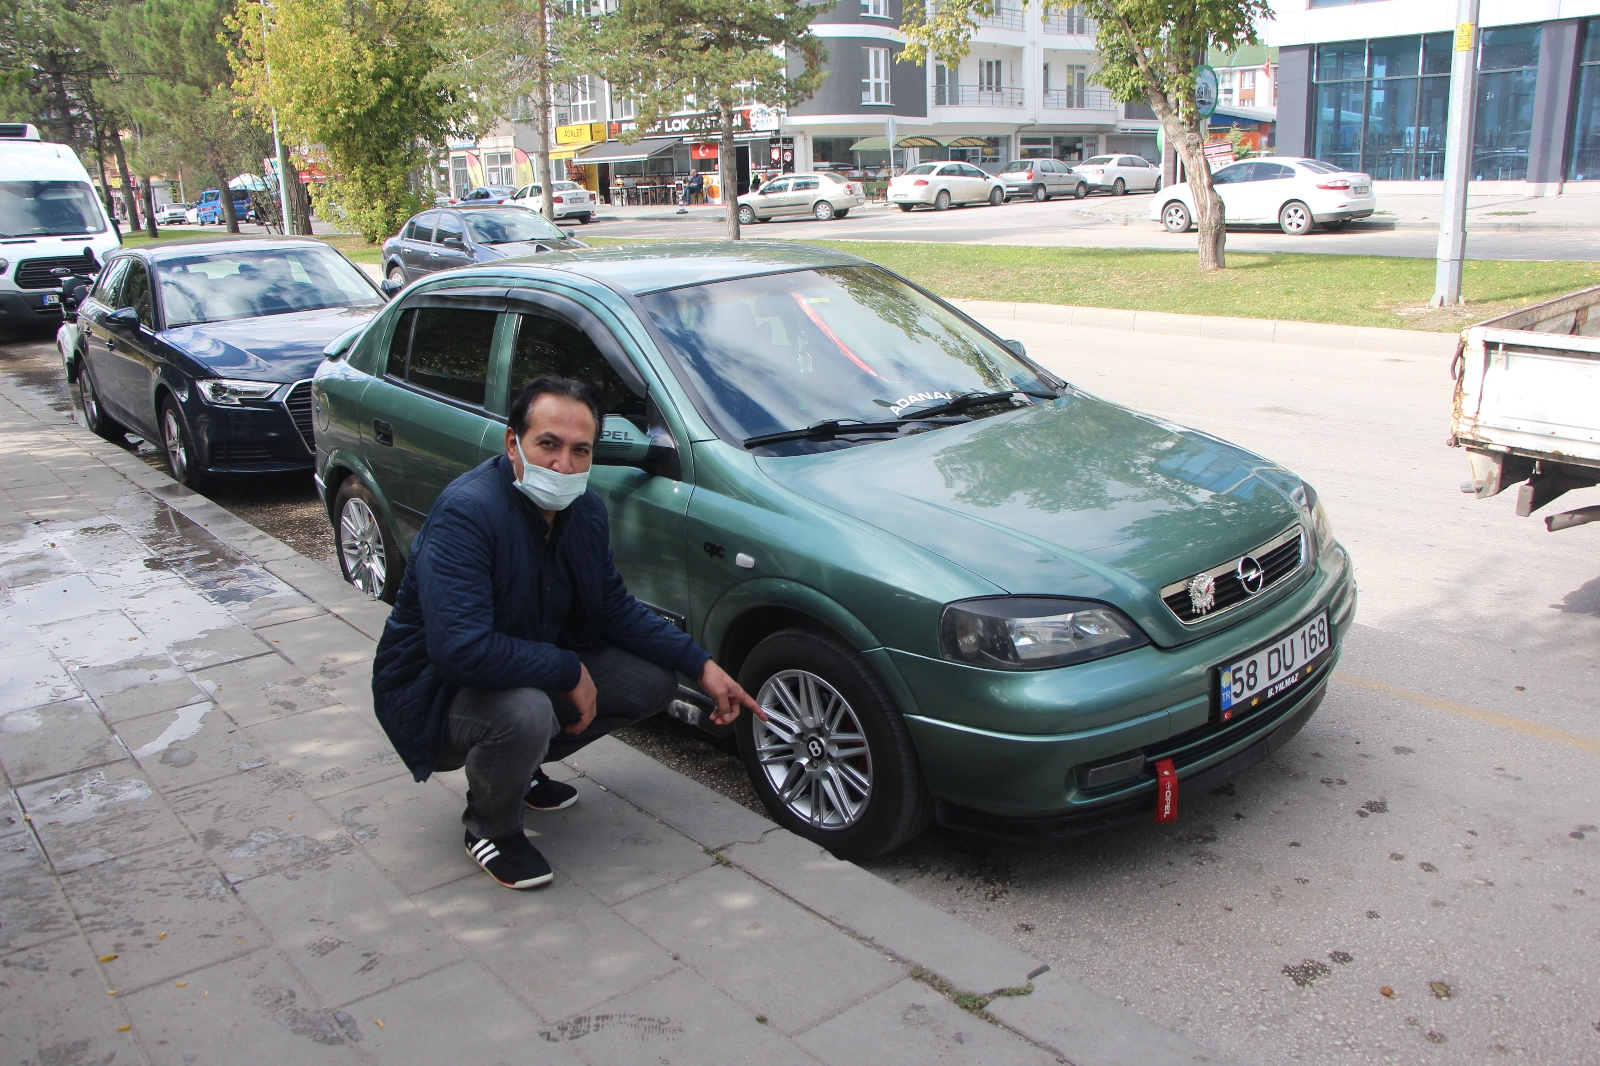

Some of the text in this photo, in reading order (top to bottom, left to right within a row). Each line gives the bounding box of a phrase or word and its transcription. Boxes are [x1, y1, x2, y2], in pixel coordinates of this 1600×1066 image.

[600, 430, 634, 442] PEL
[1231, 617, 1326, 699] 58 DU 168
[1222, 690, 1231, 702] TR
